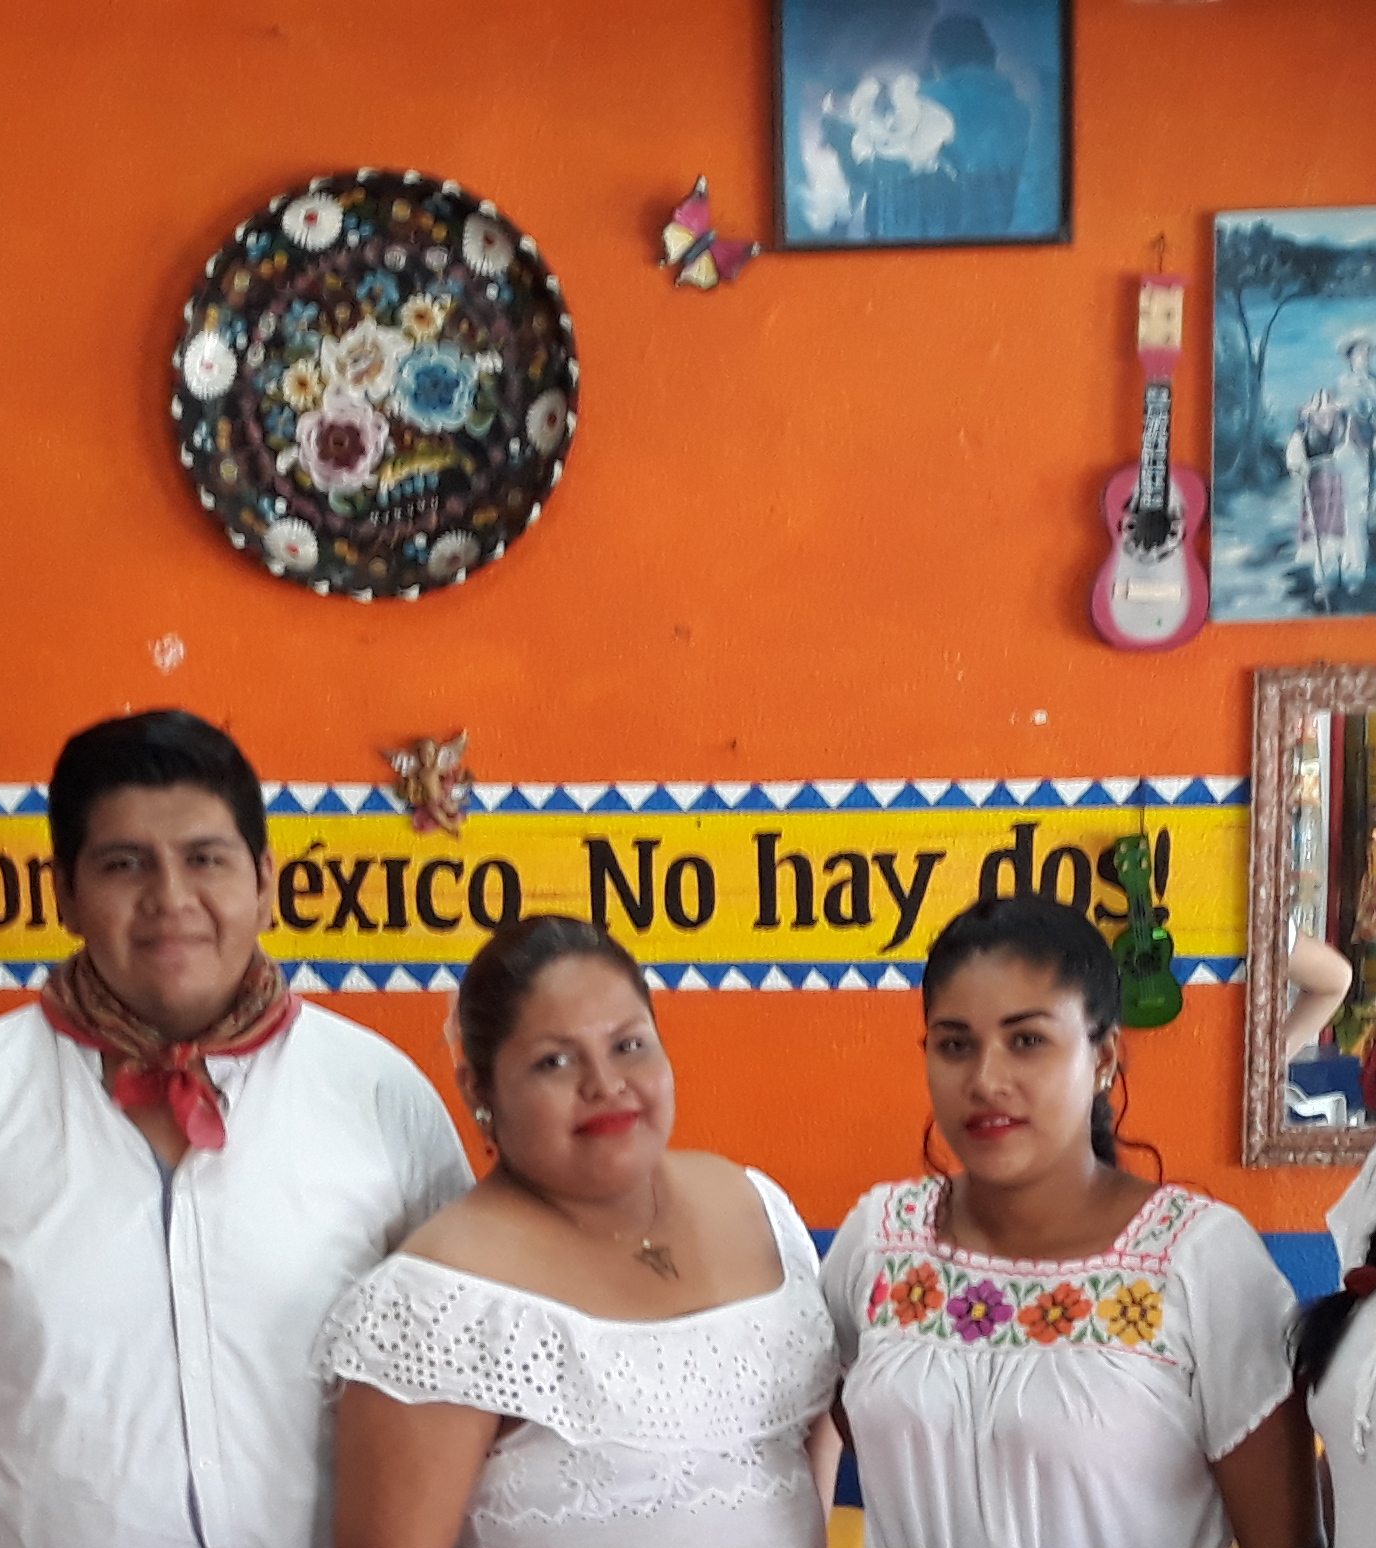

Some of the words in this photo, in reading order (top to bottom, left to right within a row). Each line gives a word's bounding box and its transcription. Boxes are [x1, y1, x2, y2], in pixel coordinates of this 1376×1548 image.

[270, 842, 523, 931] éxico
[584, 836, 717, 934] No
[752, 831, 947, 953] hay
